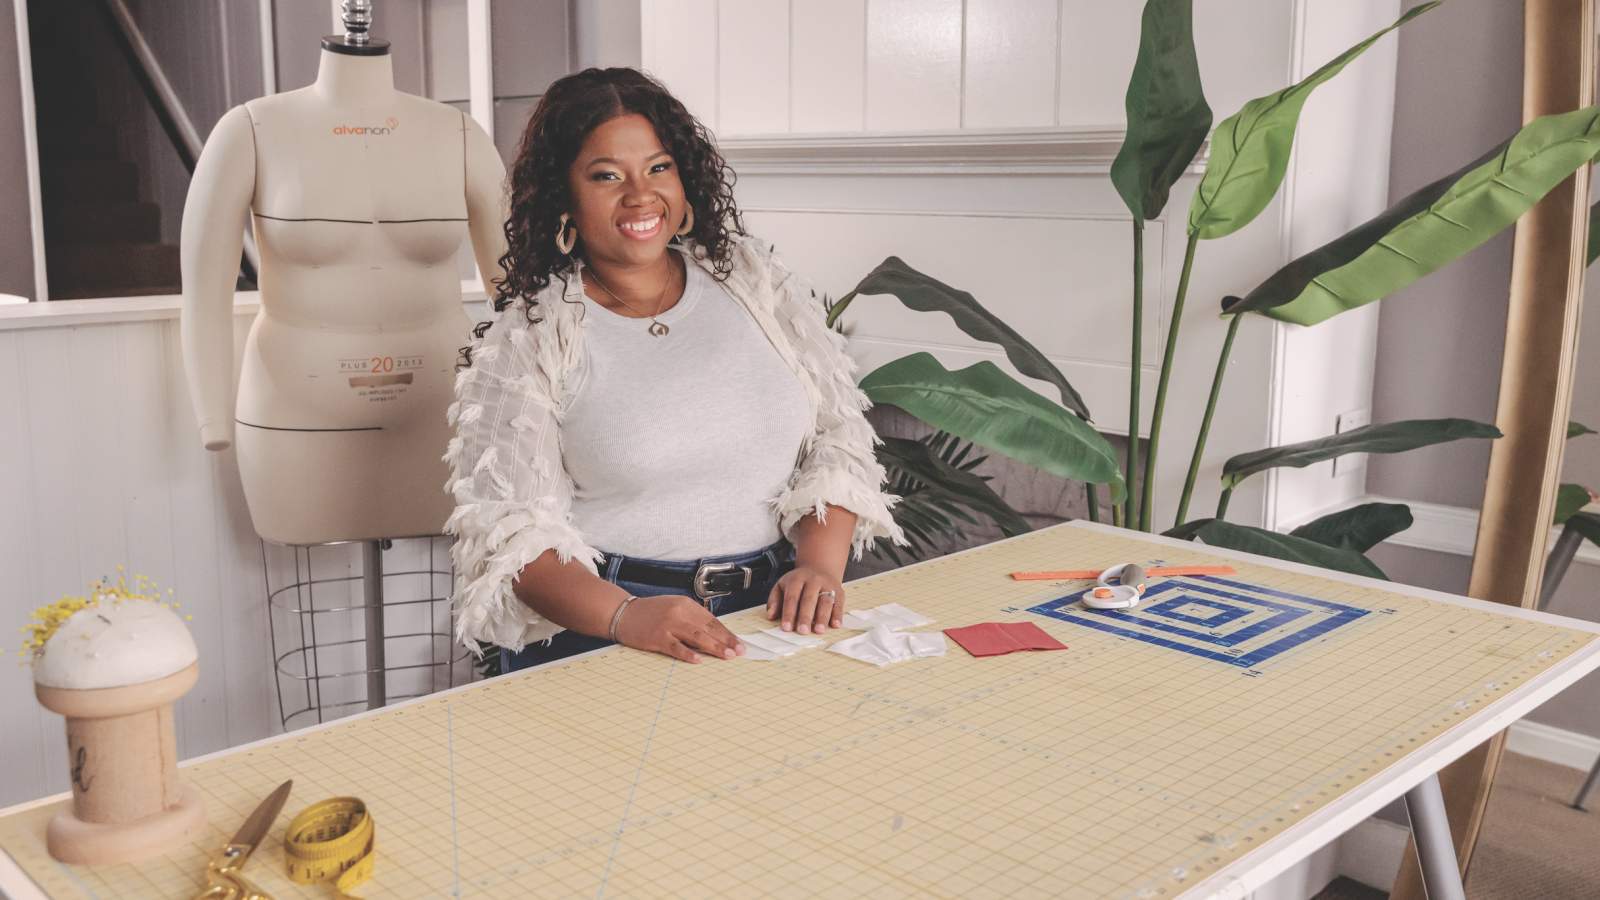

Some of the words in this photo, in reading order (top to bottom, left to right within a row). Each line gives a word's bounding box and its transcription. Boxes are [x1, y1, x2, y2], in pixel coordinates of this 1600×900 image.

[334, 124, 390, 135] alvanon
[371, 356, 394, 373] 20
[1000, 606, 1019, 614] 14
[1028, 606, 1048, 614] 12
[1233, 658, 1255, 667] 12
[1242, 669, 1263, 678] 14
[306, 866, 325, 879] 15
